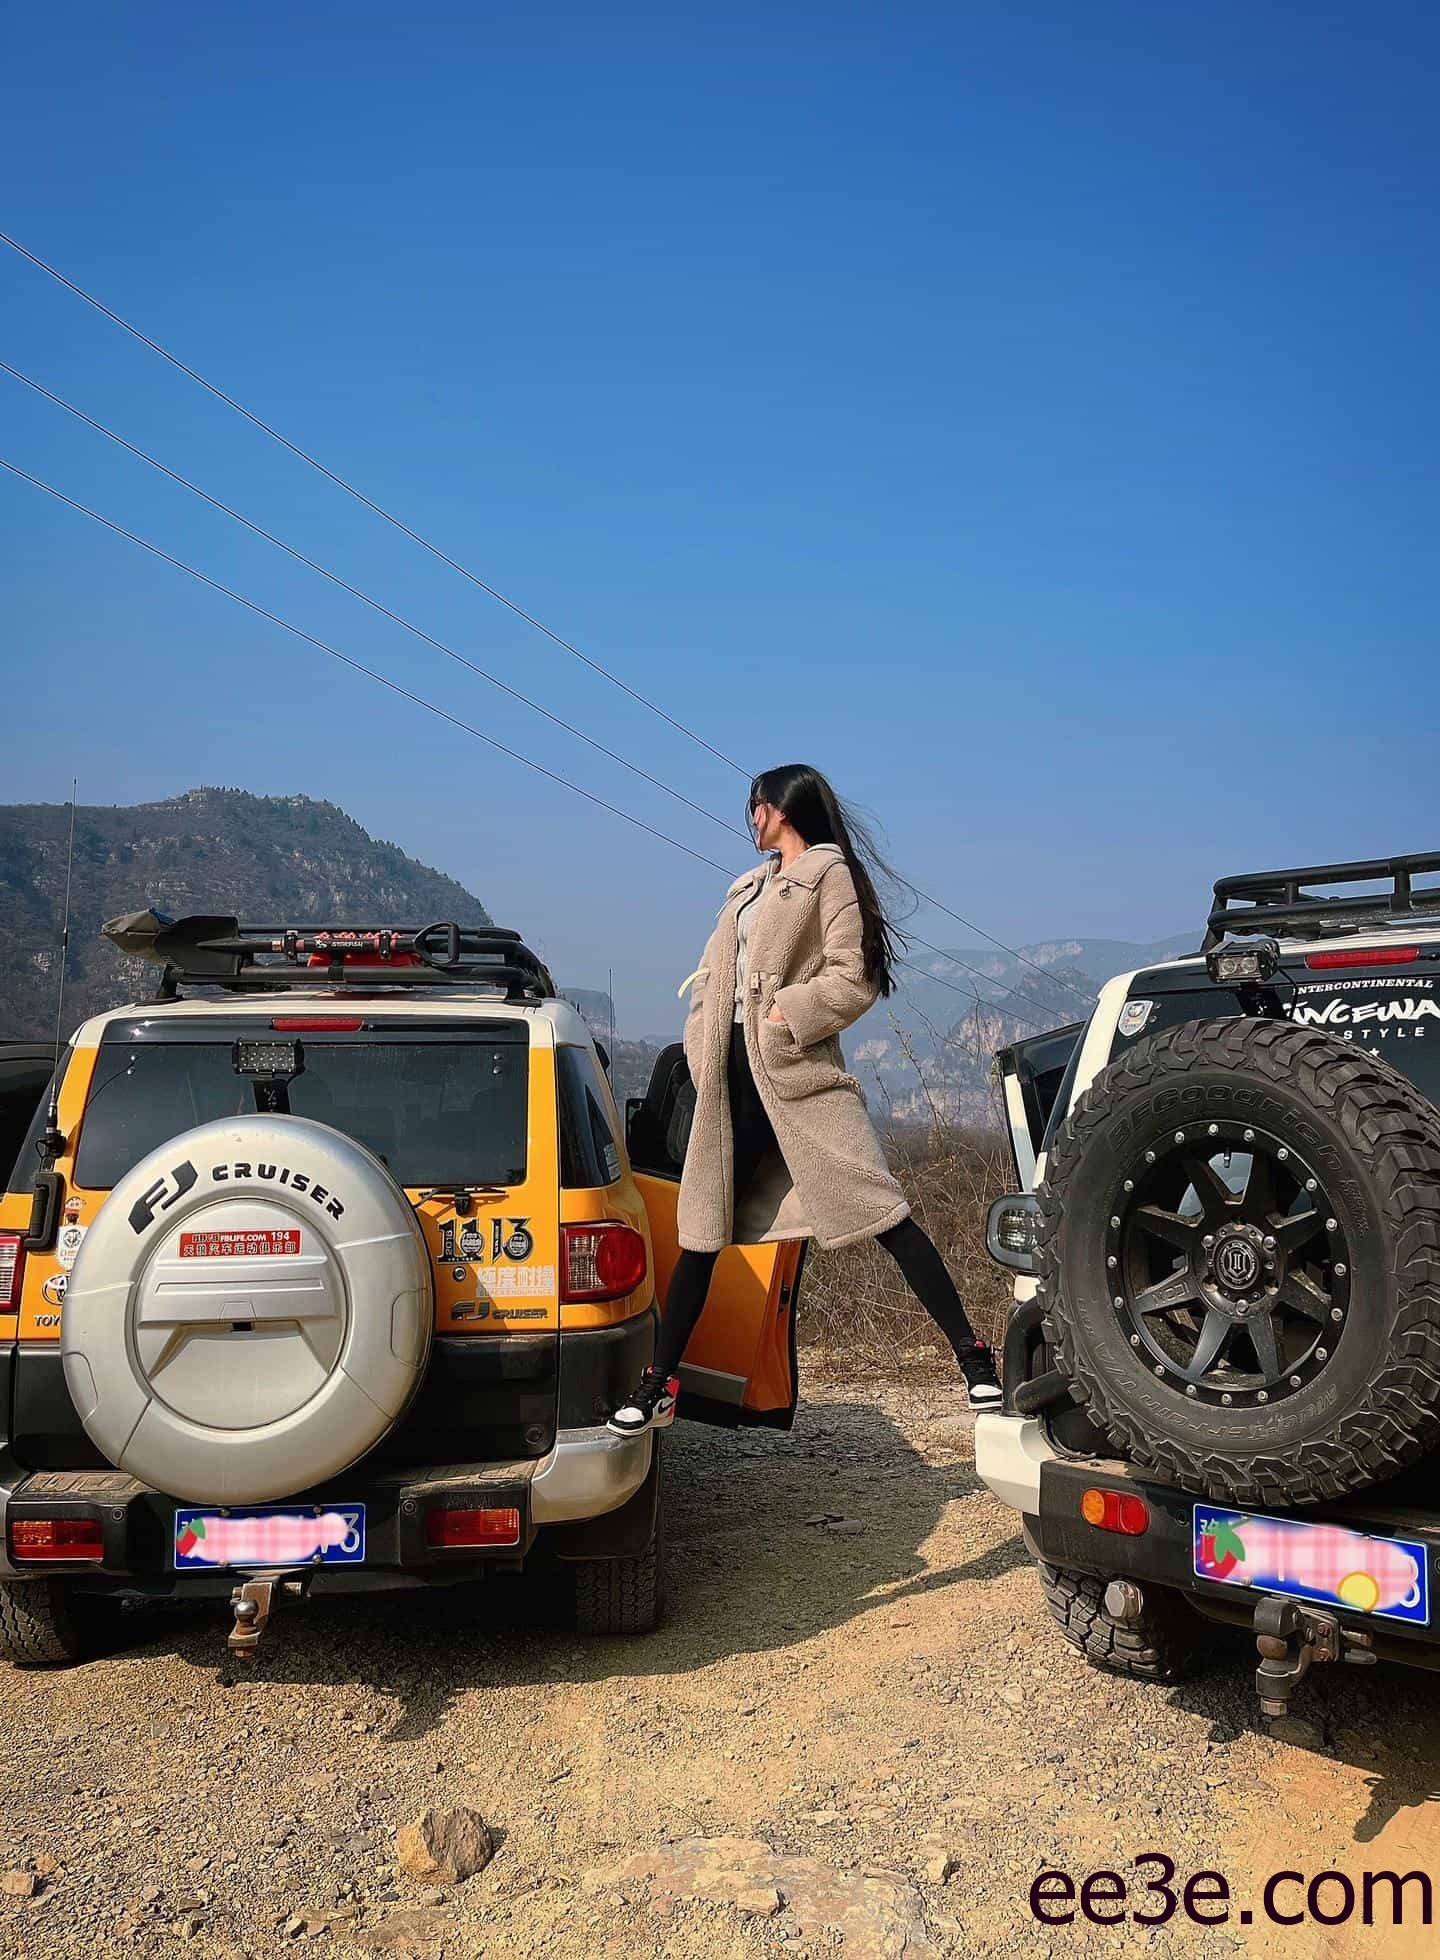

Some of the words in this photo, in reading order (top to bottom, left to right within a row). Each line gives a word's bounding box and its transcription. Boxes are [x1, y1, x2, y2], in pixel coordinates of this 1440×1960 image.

[1292, 978, 1434, 997] INTERCONTINENTAL
[1328, 1026, 1425, 1041] STYLE
[1106, 1084, 1344, 1171] BFGoodrich
[128, 1160, 198, 1235] FJ
[212, 1162, 345, 1221] CRUISER
[271, 1231, 290, 1241] 194
[451, 1300, 490, 1320] FJ
[491, 1307, 549, 1320] CRUISER
